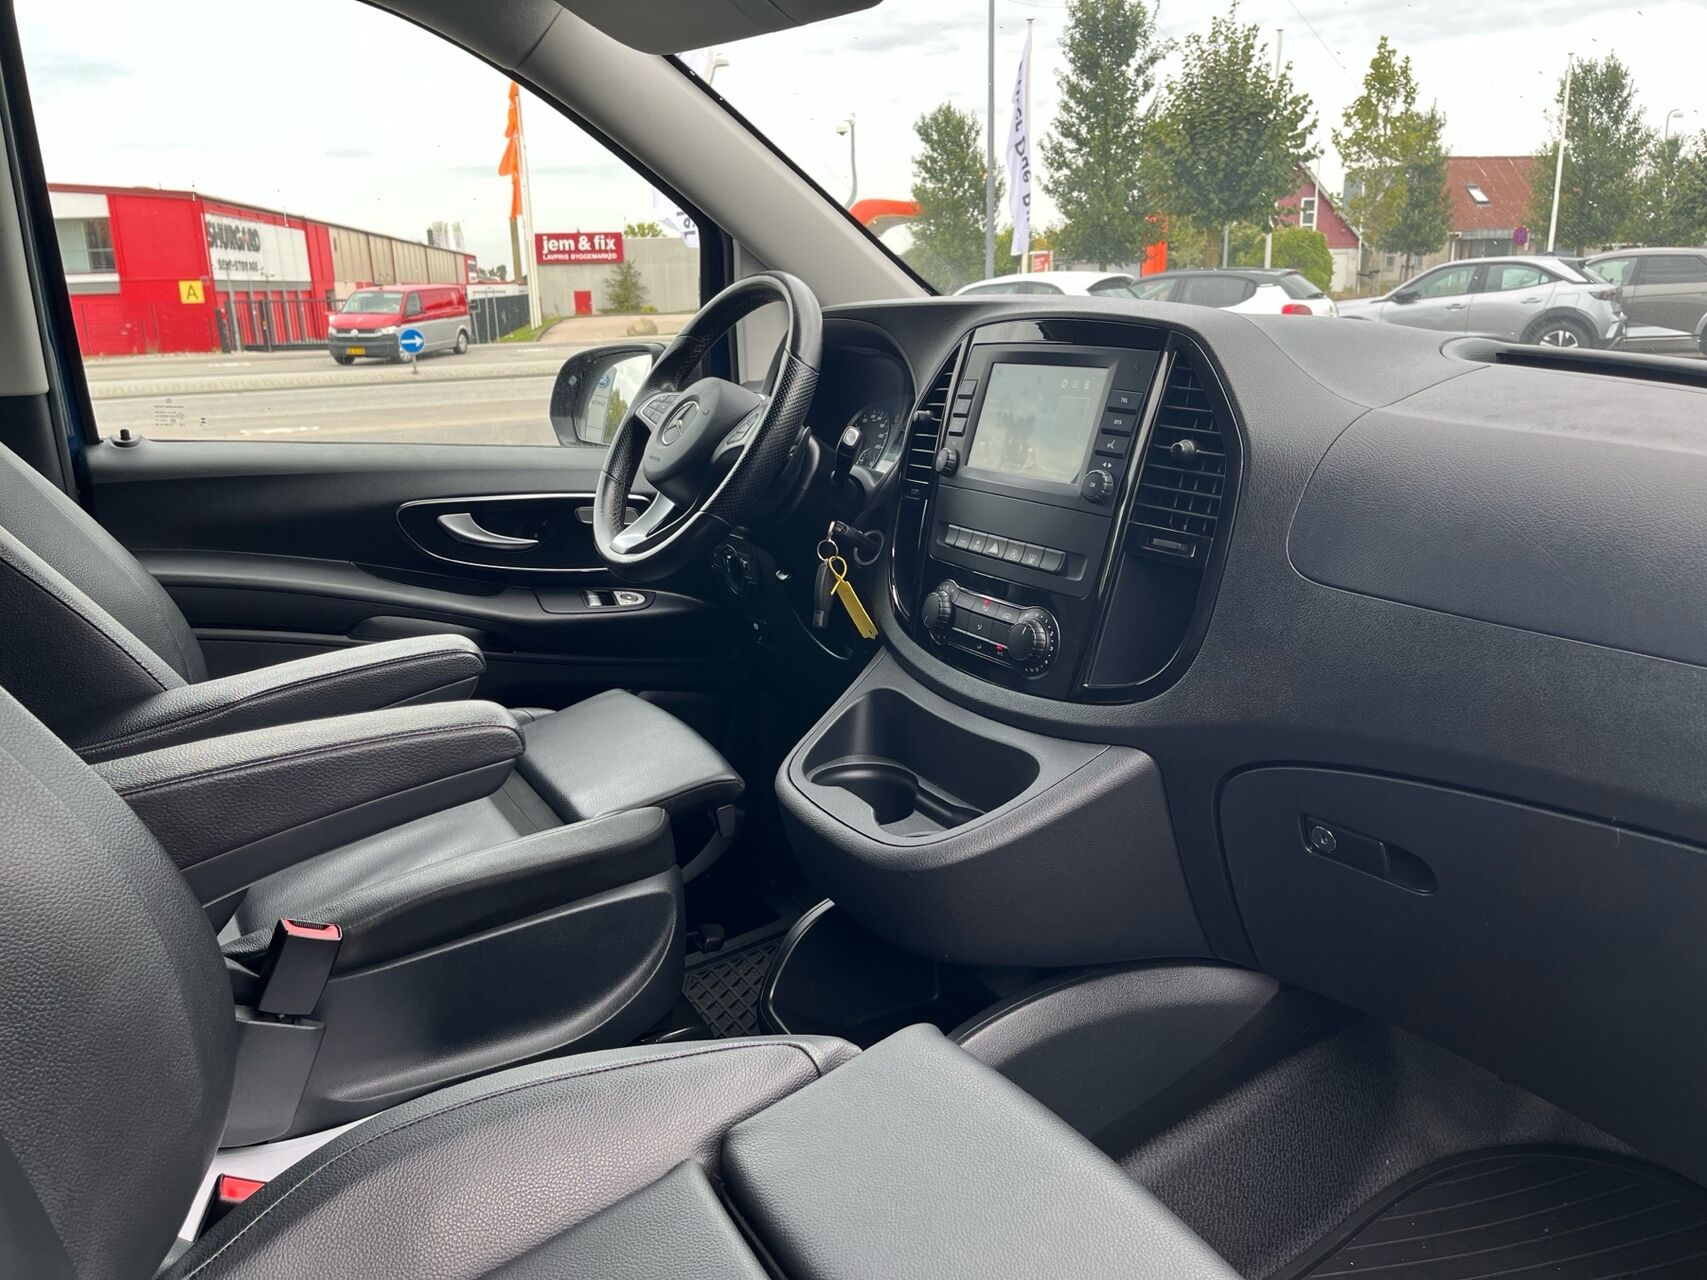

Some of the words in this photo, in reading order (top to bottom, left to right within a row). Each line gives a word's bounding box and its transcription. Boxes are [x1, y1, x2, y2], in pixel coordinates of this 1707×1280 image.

[542, 235, 576, 254] jem
[578, 235, 592, 251] &
[593, 234, 616, 251] fix
[542, 253, 570, 261] LAVPRIS
[186, 284, 199, 300] A
